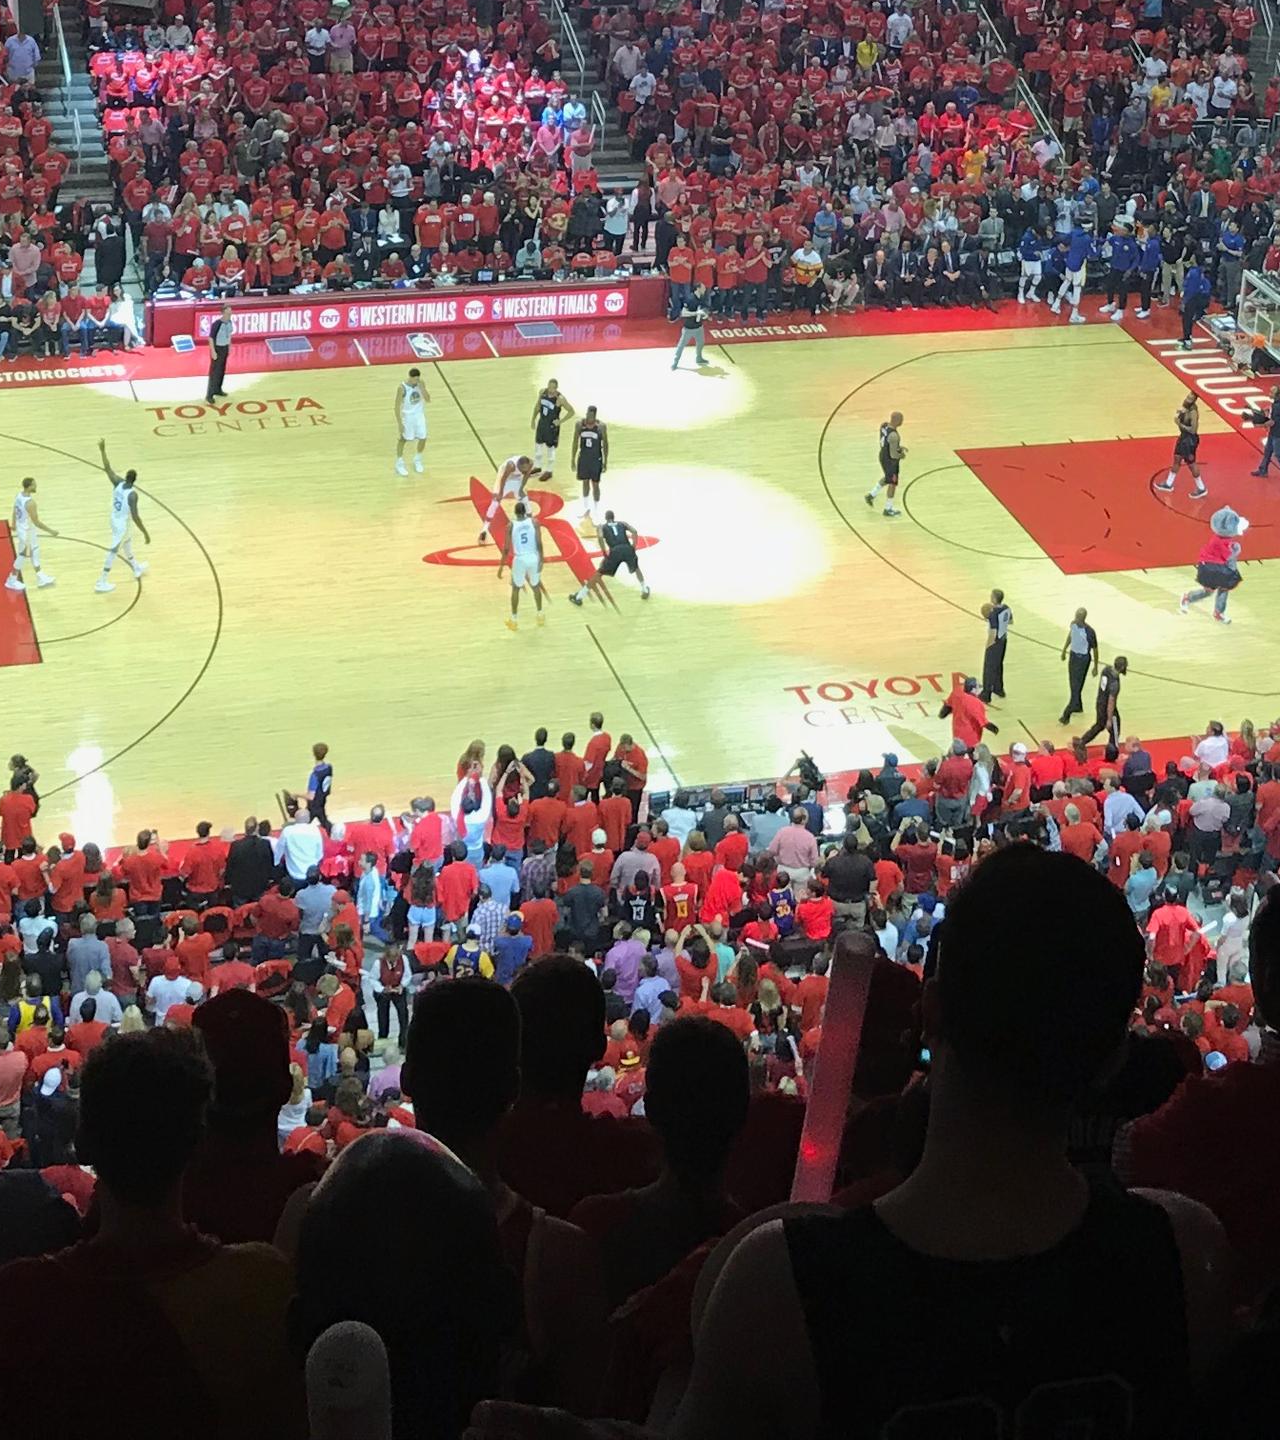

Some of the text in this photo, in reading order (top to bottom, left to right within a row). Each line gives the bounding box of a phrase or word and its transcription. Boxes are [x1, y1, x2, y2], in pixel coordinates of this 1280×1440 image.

[360, 300, 457, 327] WESTERN FINALS
[503, 293, 597, 319] WESTERN FINALS
[270, 309, 312, 332] FINALS
[708, 323, 827, 340] ROCKETS.COM
[144, 396, 324, 422] TOYOTA
[152, 413, 334, 438] CENTER
[520, 532, 529, 545] 5
[784, 671, 971, 705] TOYOTA
[803, 698, 946, 728] CENT
